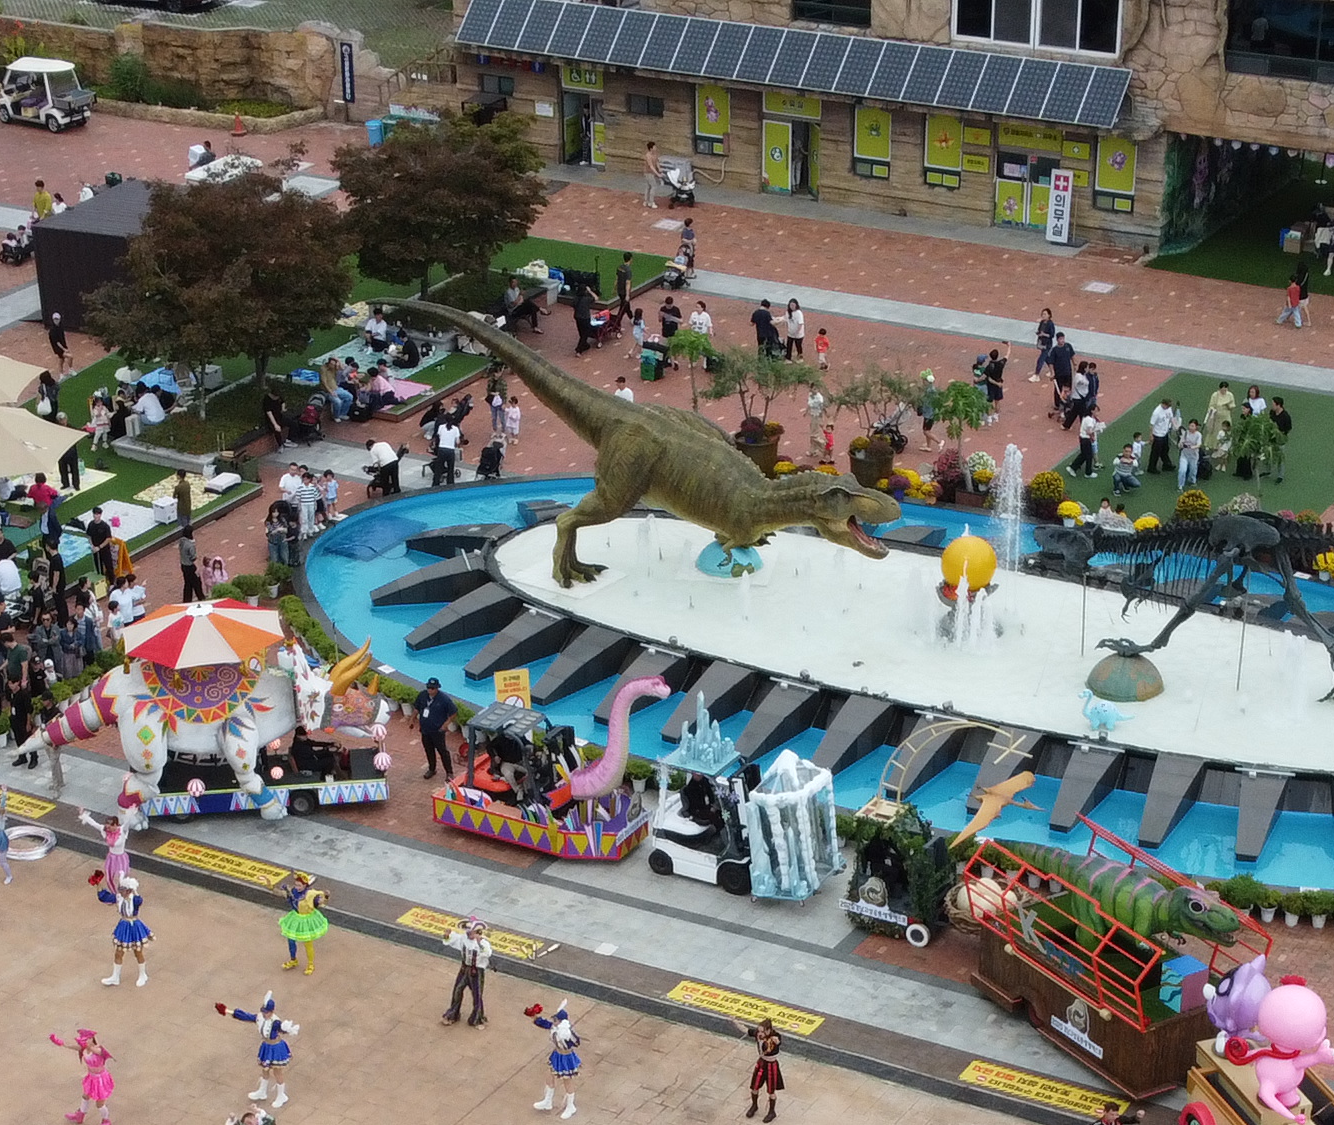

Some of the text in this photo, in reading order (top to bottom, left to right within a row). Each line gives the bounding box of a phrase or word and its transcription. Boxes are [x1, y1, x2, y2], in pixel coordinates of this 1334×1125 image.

[1052, 194, 1066, 237] 의무실
[680, 984, 701, 994] 금지
[971, 1064, 995, 1075] 금지
[992, 1070, 1017, 1081] 절대
[986, 1078, 1035, 1094] 구역입니다
[1015, 1076, 1041, 1087] 설치
[1037, 1082, 1075, 1096] 돗자리
